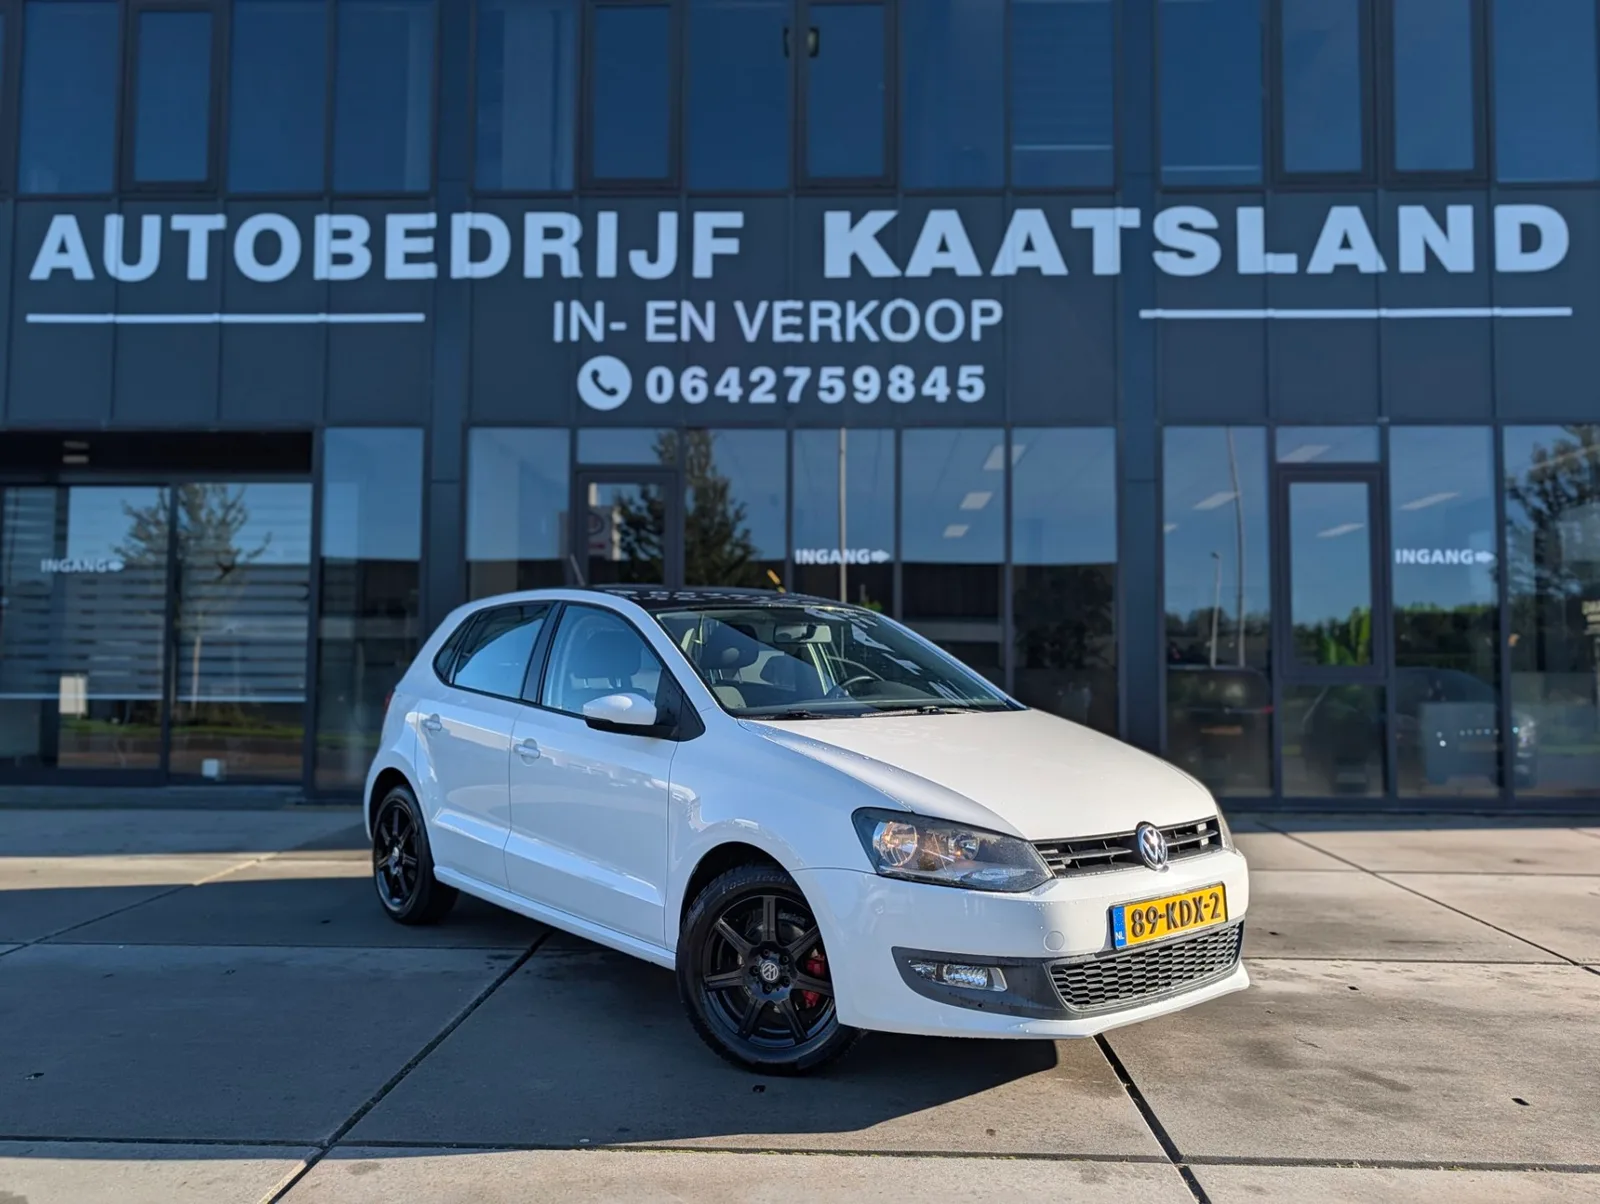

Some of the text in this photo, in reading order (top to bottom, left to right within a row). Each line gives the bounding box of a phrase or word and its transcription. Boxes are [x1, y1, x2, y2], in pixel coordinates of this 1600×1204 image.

[29, 204, 1570, 282] AUTOBEDRIJF KAATSLAND
[552, 299, 1004, 343] IN- EN VERKOOP
[645, 365, 987, 405] 0642759845
[40, 558, 107, 573] INGANG
[794, 548, 870, 565] INGANG
[1395, 548, 1474, 565] INGANG
[1115, 892, 1221, 941] NL 89-KDX-2
